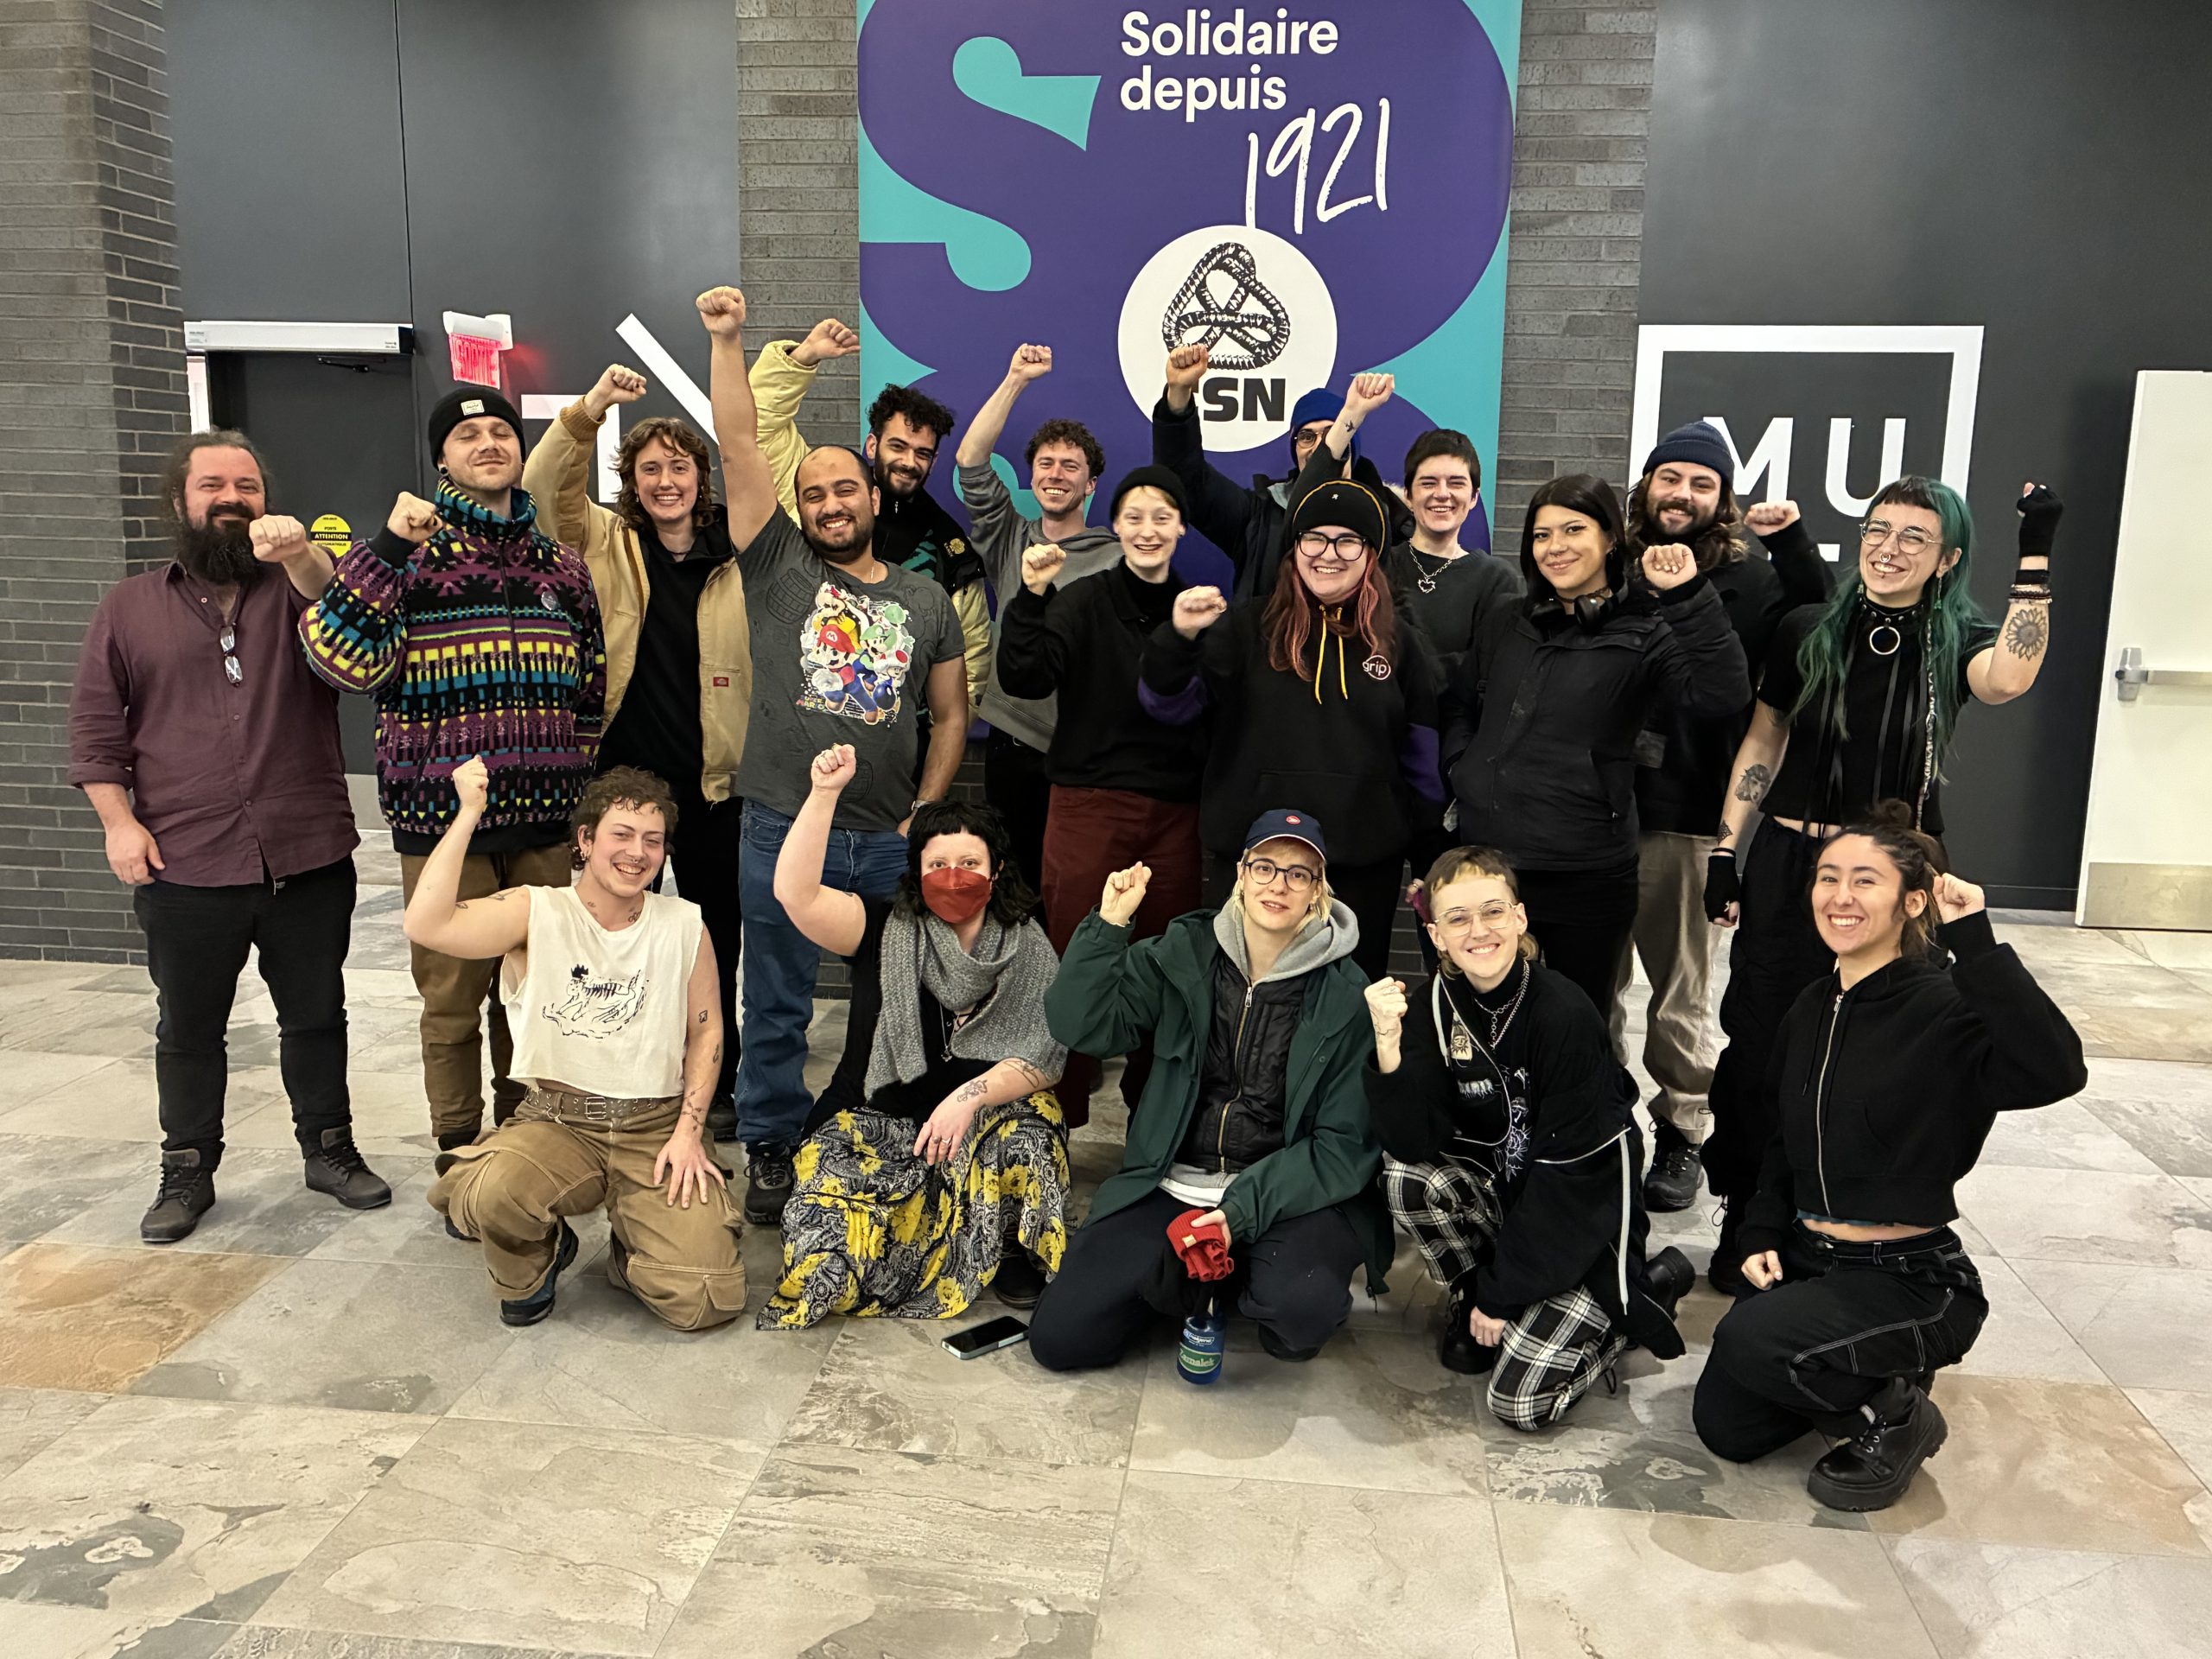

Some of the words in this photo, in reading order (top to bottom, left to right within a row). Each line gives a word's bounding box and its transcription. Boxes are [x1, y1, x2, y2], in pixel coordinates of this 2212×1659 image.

[1121, 9, 1338, 56] Solidaire
[1120, 64, 1287, 123] depuis
[1245, 98, 1390, 235] 1921
[454, 338, 499, 389] SORTIE
[1193, 377, 1286, 422] SN
[1362, 661, 1387, 677] grip
